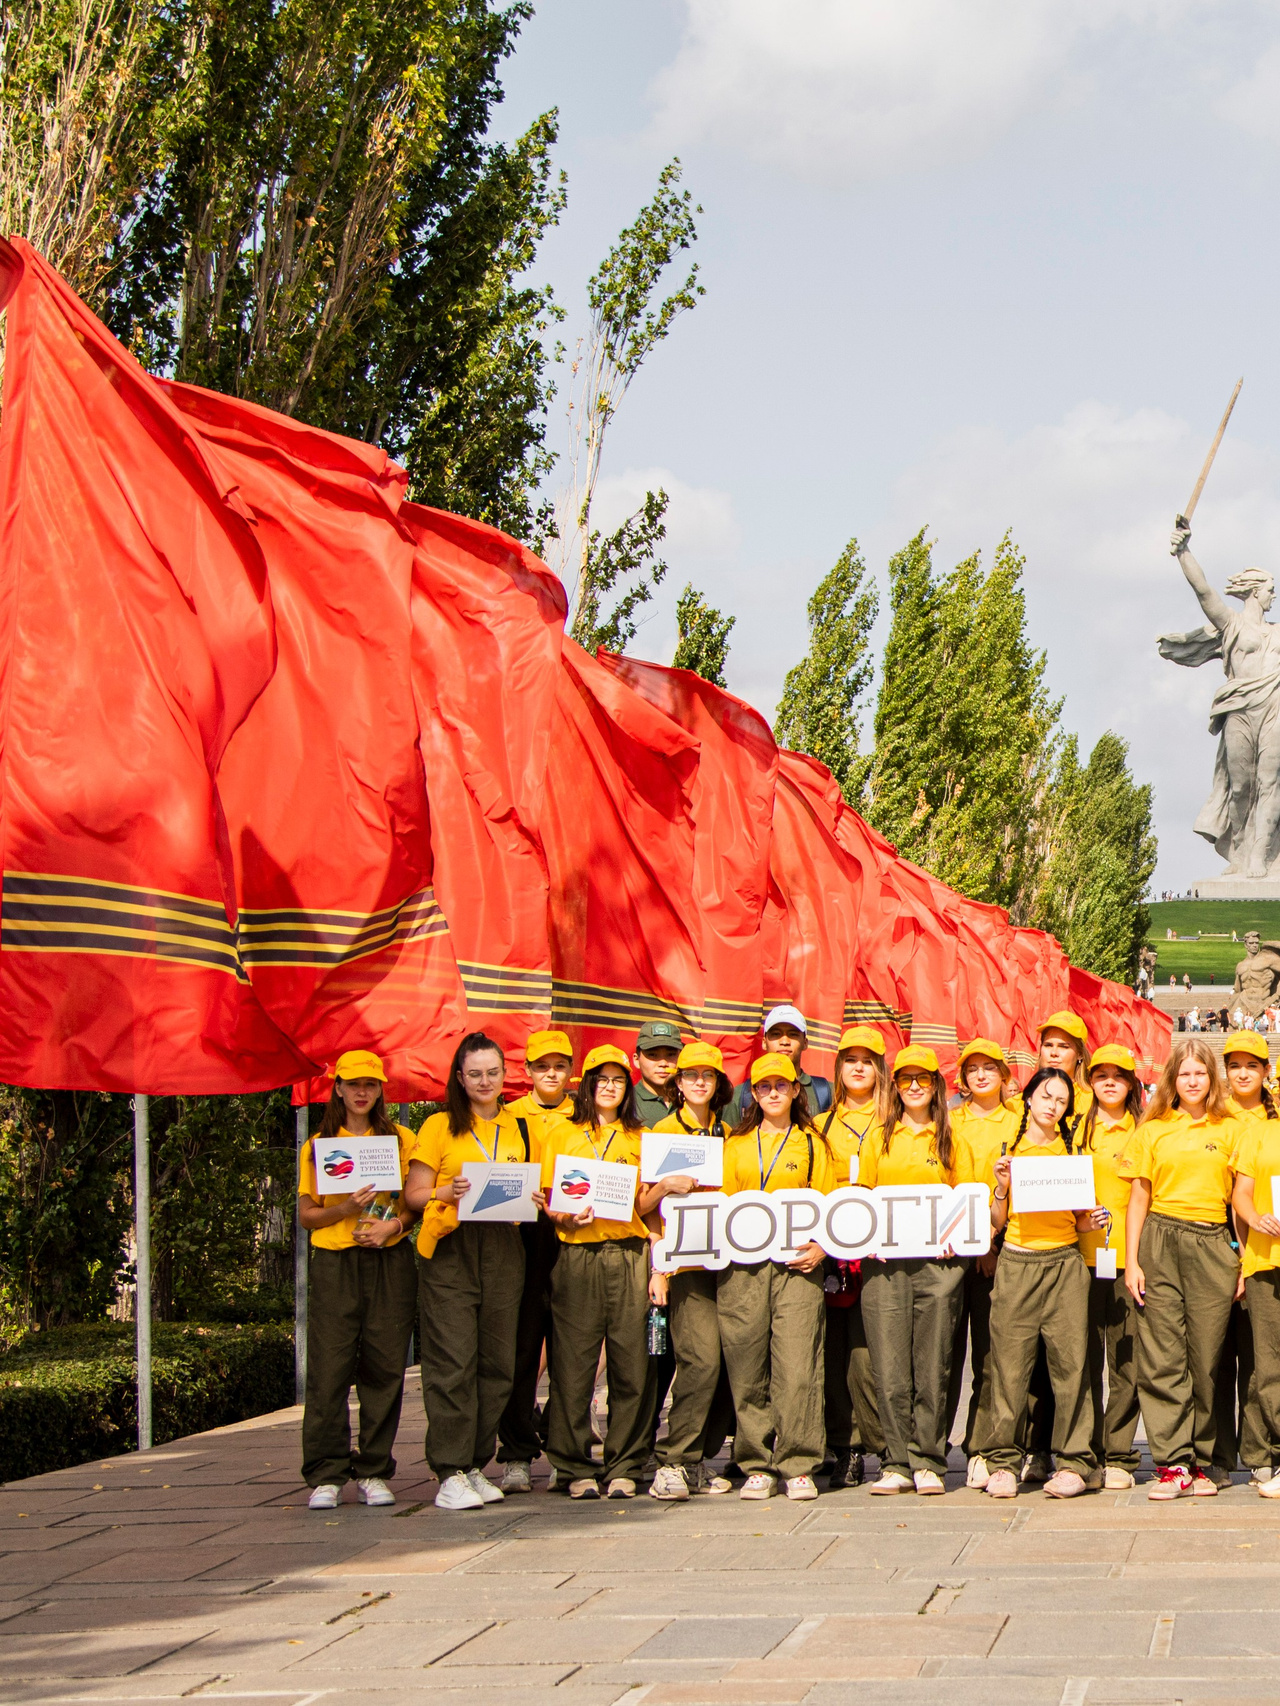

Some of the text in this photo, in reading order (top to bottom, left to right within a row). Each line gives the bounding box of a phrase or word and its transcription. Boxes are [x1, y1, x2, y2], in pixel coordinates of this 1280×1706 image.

[598, 1174, 632, 1183] АГЕНТСТВО
[1019, 1177, 1087, 1187] ДОРОГИ ПОБЕДЫ
[596, 1179, 631, 1189] РАЗВИТИЯ
[595, 1185, 631, 1195] ВНУТРЕННЕГО
[595, 1190, 629, 1201] ТУРИЗМА
[665, 1193, 982, 1262] ДОРОГИ
